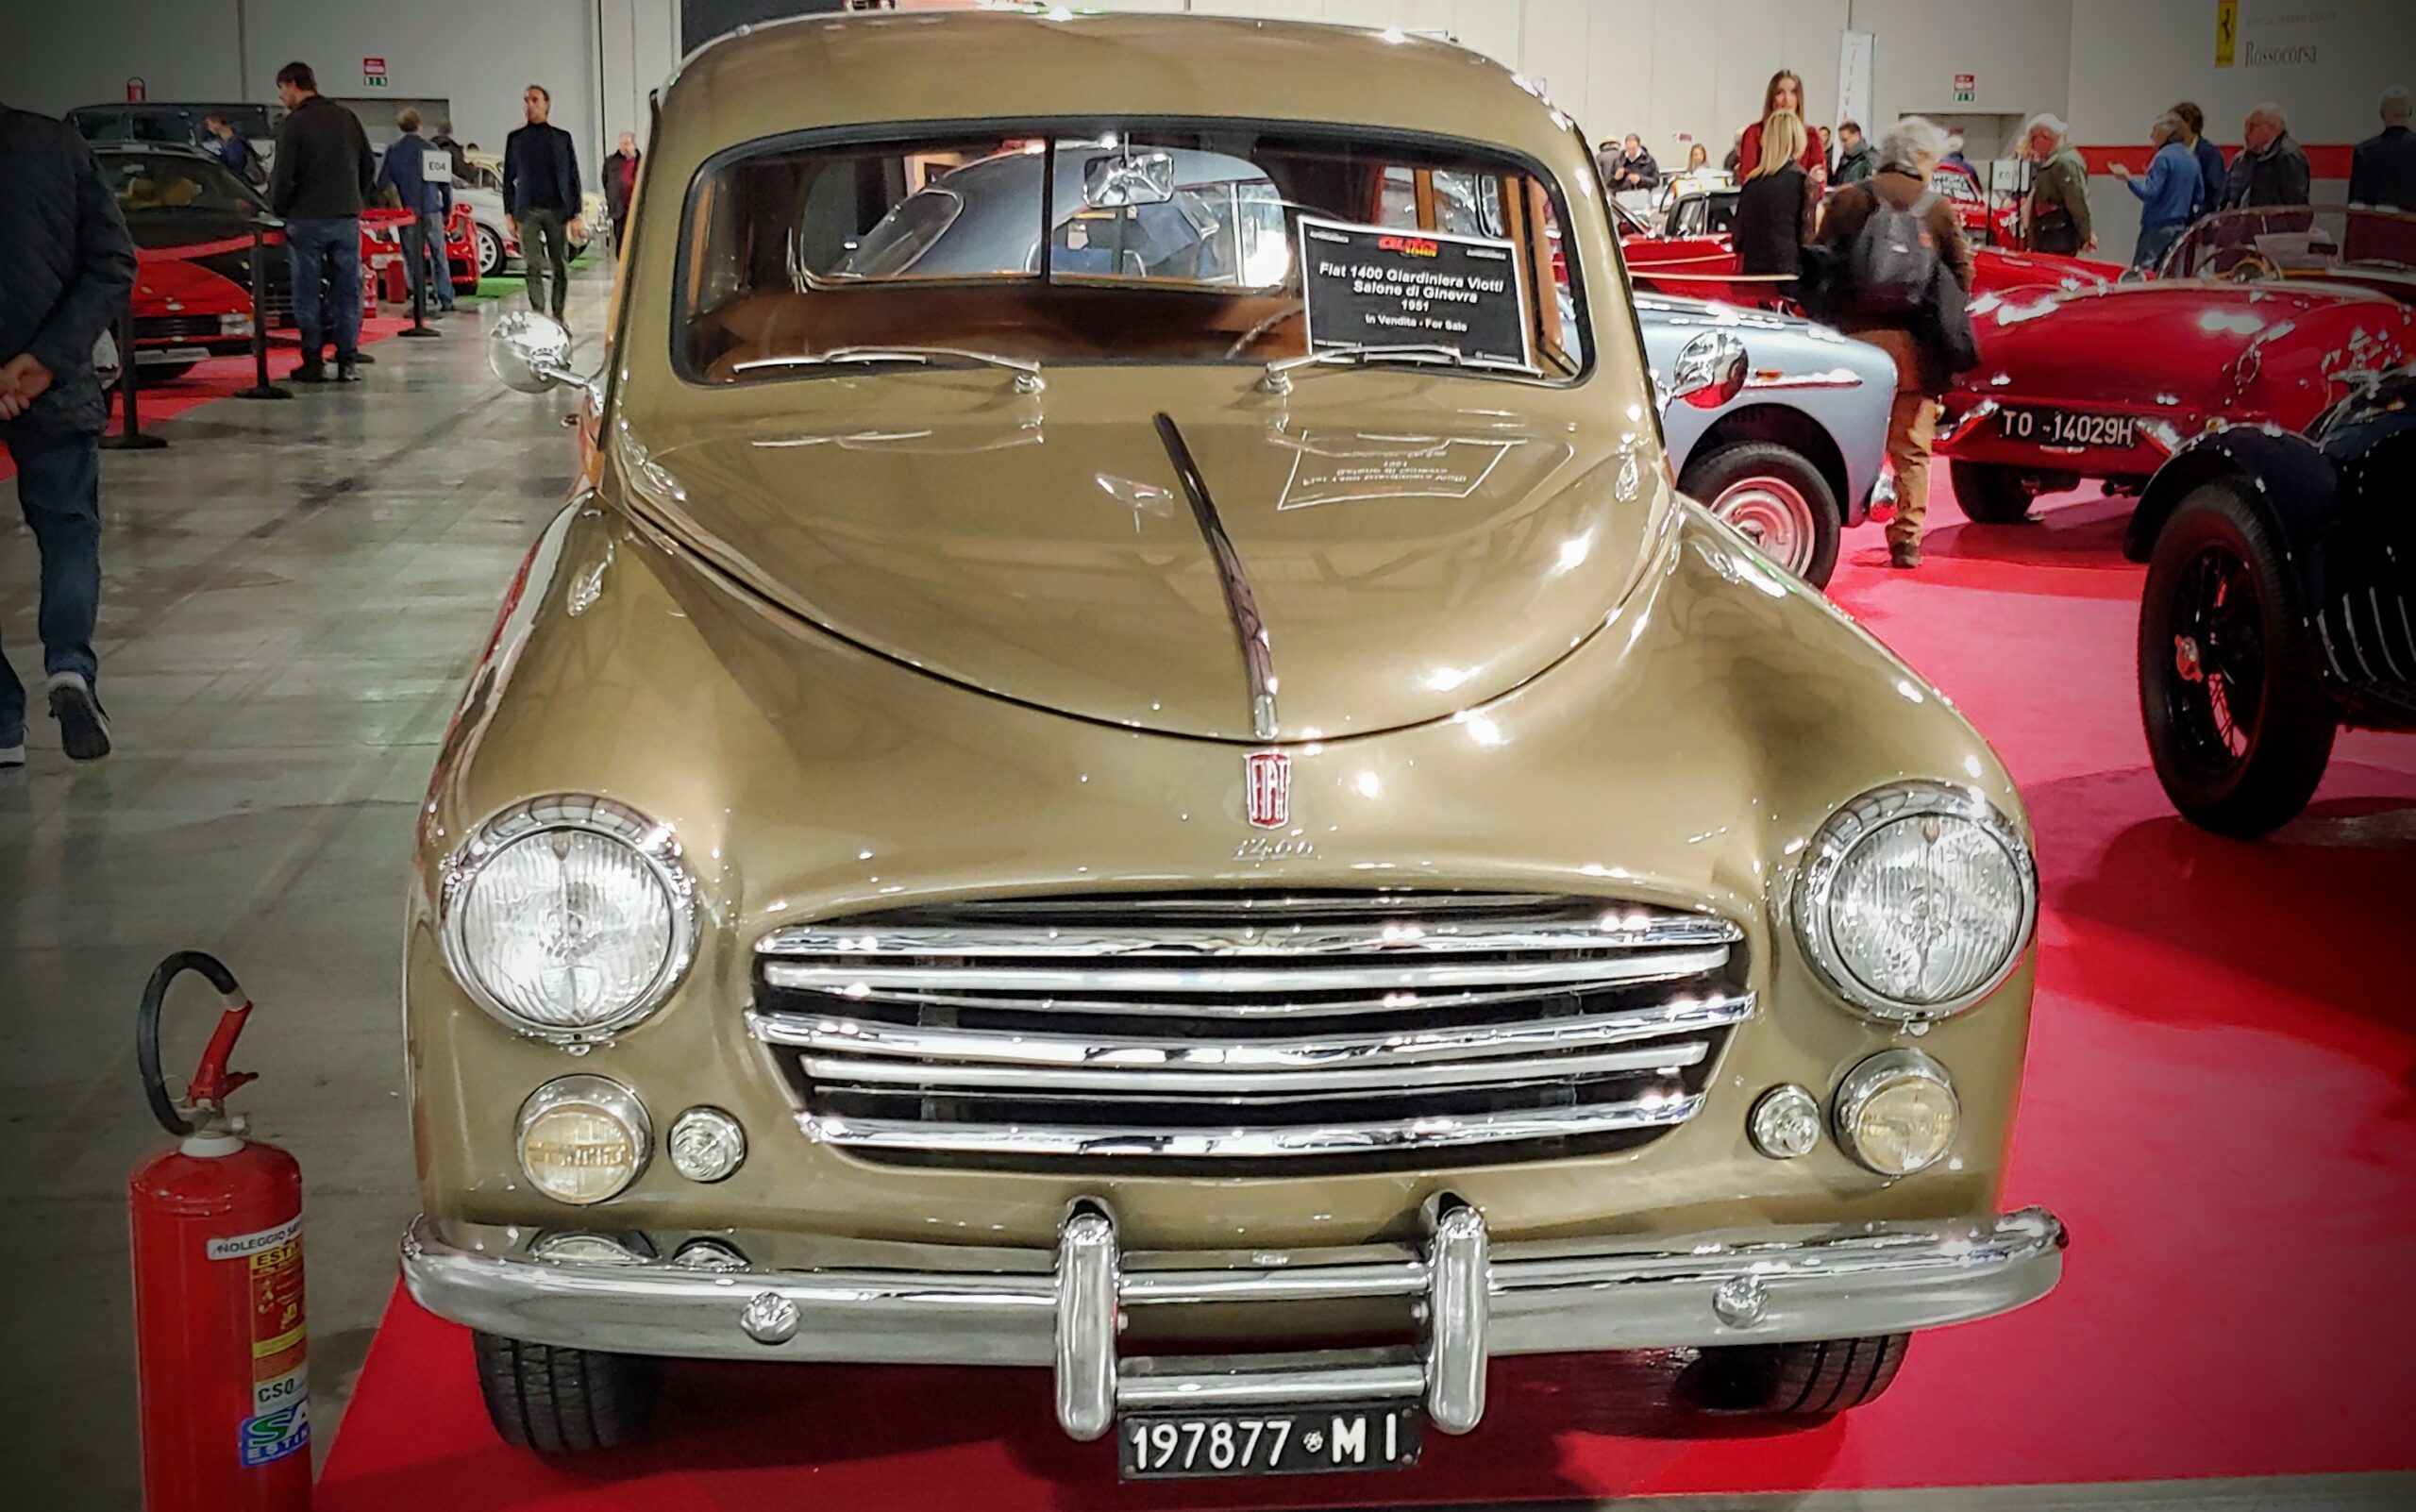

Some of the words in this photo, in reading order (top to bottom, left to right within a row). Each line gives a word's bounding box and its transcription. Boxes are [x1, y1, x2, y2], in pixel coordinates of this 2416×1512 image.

[2245, 41, 2317, 67] Rossocorsa
[1319, 262, 1346, 277] Fiat
[1350, 265, 1384, 281] 1400
[1386, 268, 1464, 288] Giardiniera
[1467, 276, 1504, 293] Viotti
[1353, 280, 1402, 296] Salone
[1405, 285, 1419, 298] di
[1422, 287, 1478, 304] Ginevra
[1401, 299, 1430, 312] 1951
[1365, 313, 1376, 325] In
[1378, 314, 1417, 328] Vendita
[1425, 319, 1443, 329] For
[1445, 320, 1468, 332] Sale
[2003, 411, 2033, 437] TO
[2054, 413, 2136, 446] 14029H
[1250, 759, 1289, 820] FIAT
[217, 1231, 285, 1254] NOLEGGIO
[1132, 1420, 1293, 1470] 197877
